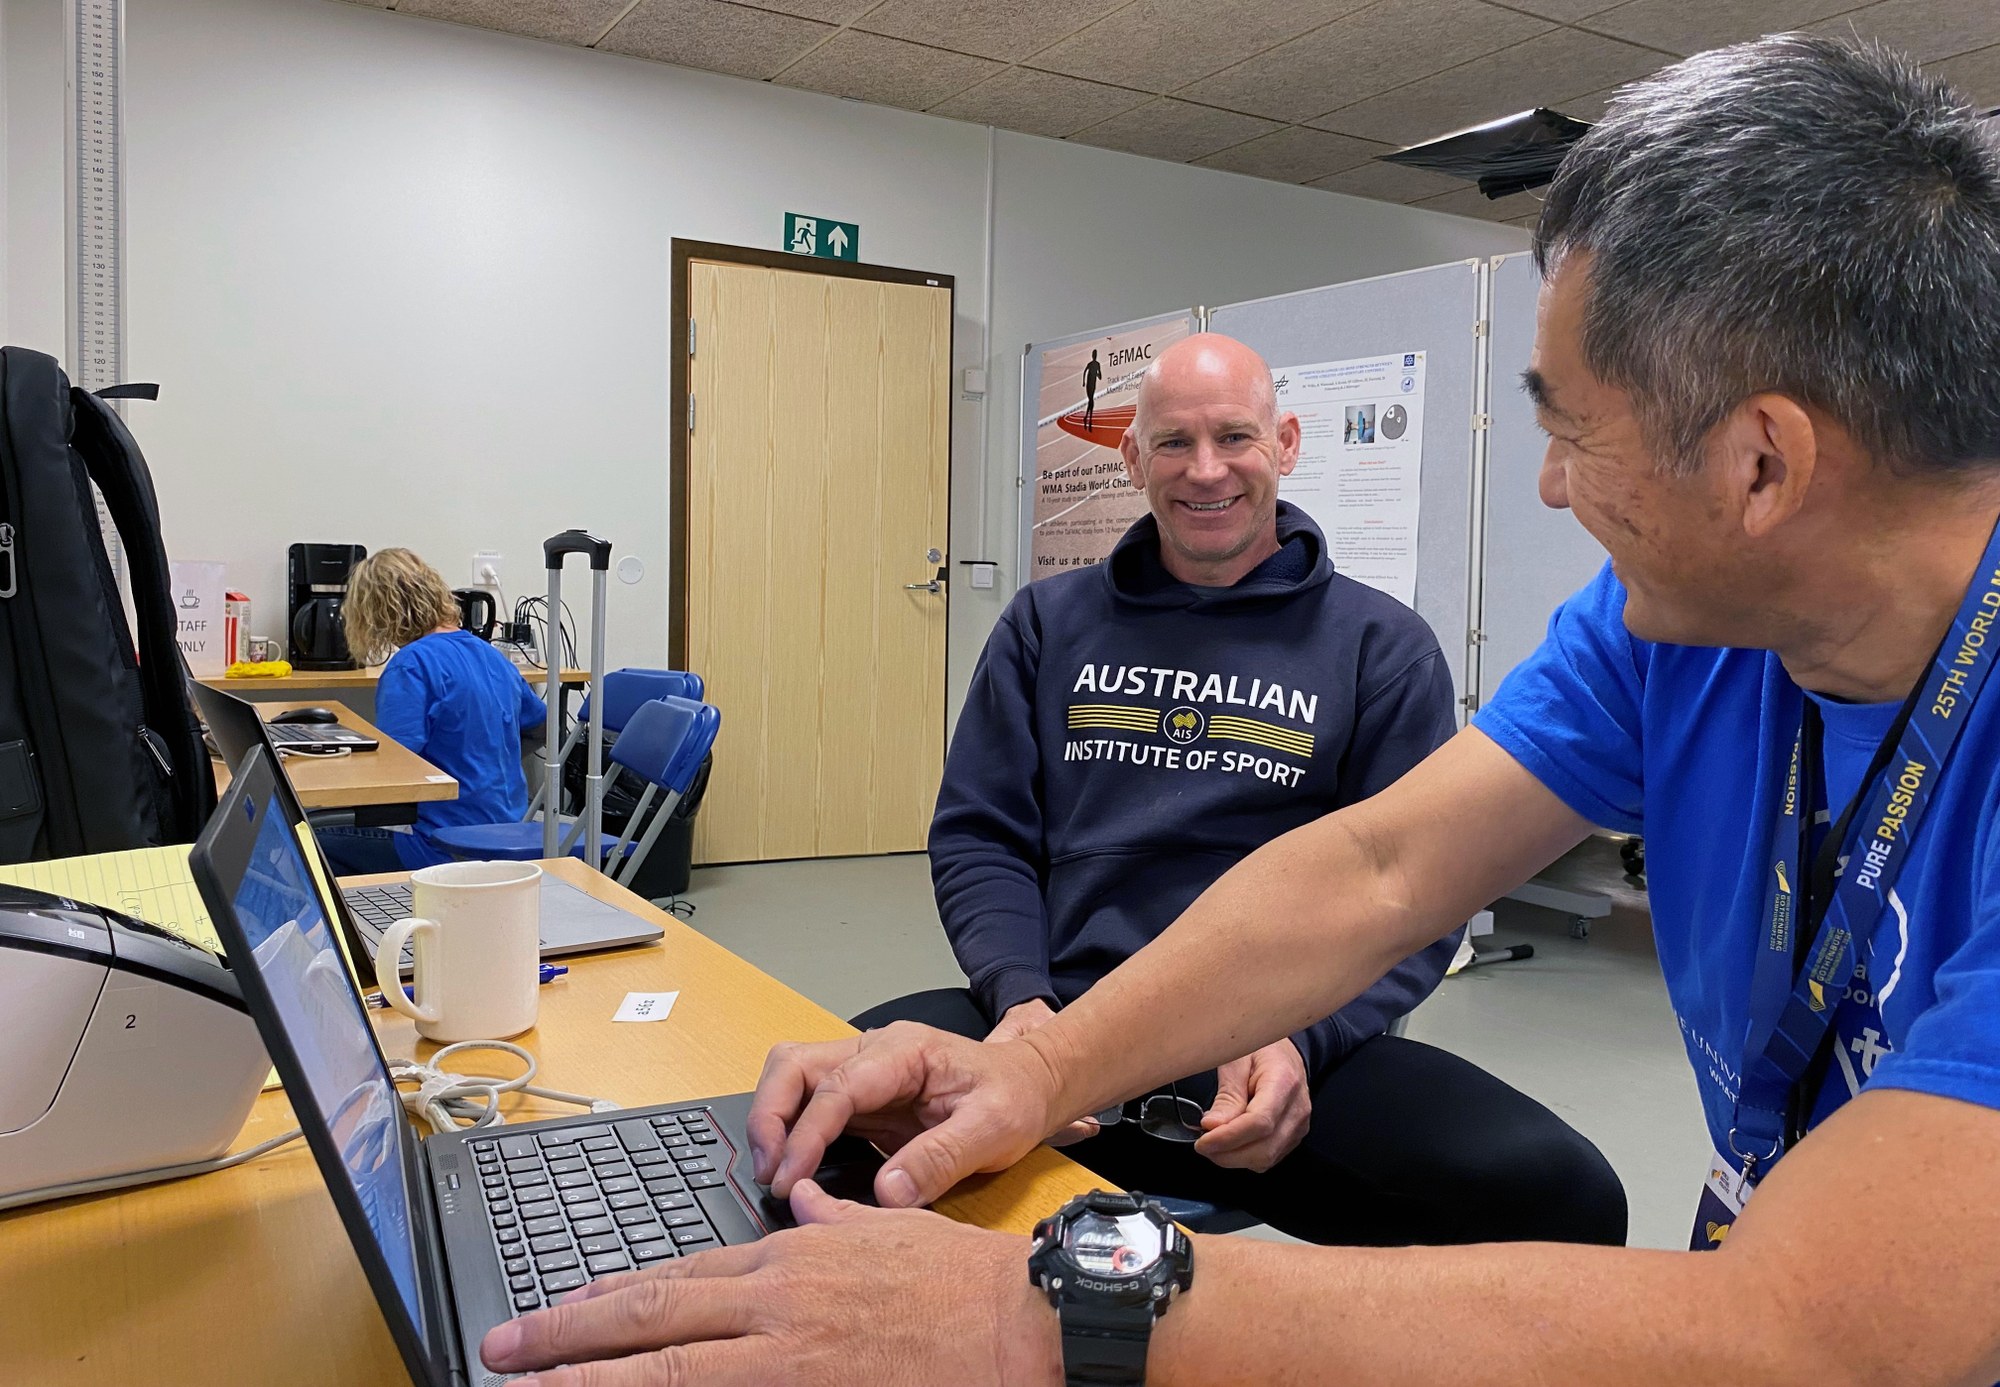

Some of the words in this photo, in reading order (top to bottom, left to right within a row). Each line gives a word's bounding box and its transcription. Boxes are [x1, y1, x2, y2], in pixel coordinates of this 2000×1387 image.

[92, 70, 104, 79] 150
[92, 166, 105, 175] 140
[92, 262, 105, 270] 130
[1108, 344, 1152, 367] TaFMAC
[1042, 470, 1053, 480] Be
[1055, 469, 1071, 481] part
[1072, 466, 1081, 477] of
[1081, 468, 1093, 476] our
[1042, 484, 1063, 494] WMA
[1065, 482, 1087, 493] Stadia
[1089, 479, 1110, 490] World
[1038, 556, 1055, 566] Visit
[1058, 557, 1068, 566] us
[1072, 556, 1080, 565] at
[1083, 557, 1096, 565] our
[178, 620, 207, 631] TAFF
[1932, 669, 1968, 719] 25TH
[1955, 591, 2000, 665] WORLD
[1073, 664, 1318, 724] AUSTRALIAN
[1172, 728, 1192, 739] AIS
[1064, 739, 1182, 769] INSTITUTE
[1185, 750, 1218, 770] OF
[1221, 751, 1306, 788] SPORT
[1784, 742, 1800, 815] PASSION
[1856, 839, 1892, 889] PURE
[1876, 760, 1927, 841] PASSION
[1776, 895, 1786, 952] GOTHENBURG
[1816, 928, 1845, 982] GOTHENBURG
[126, 1014, 136, 1029] 2
[1075, 1275, 1139, 1292] G-SHOCK
